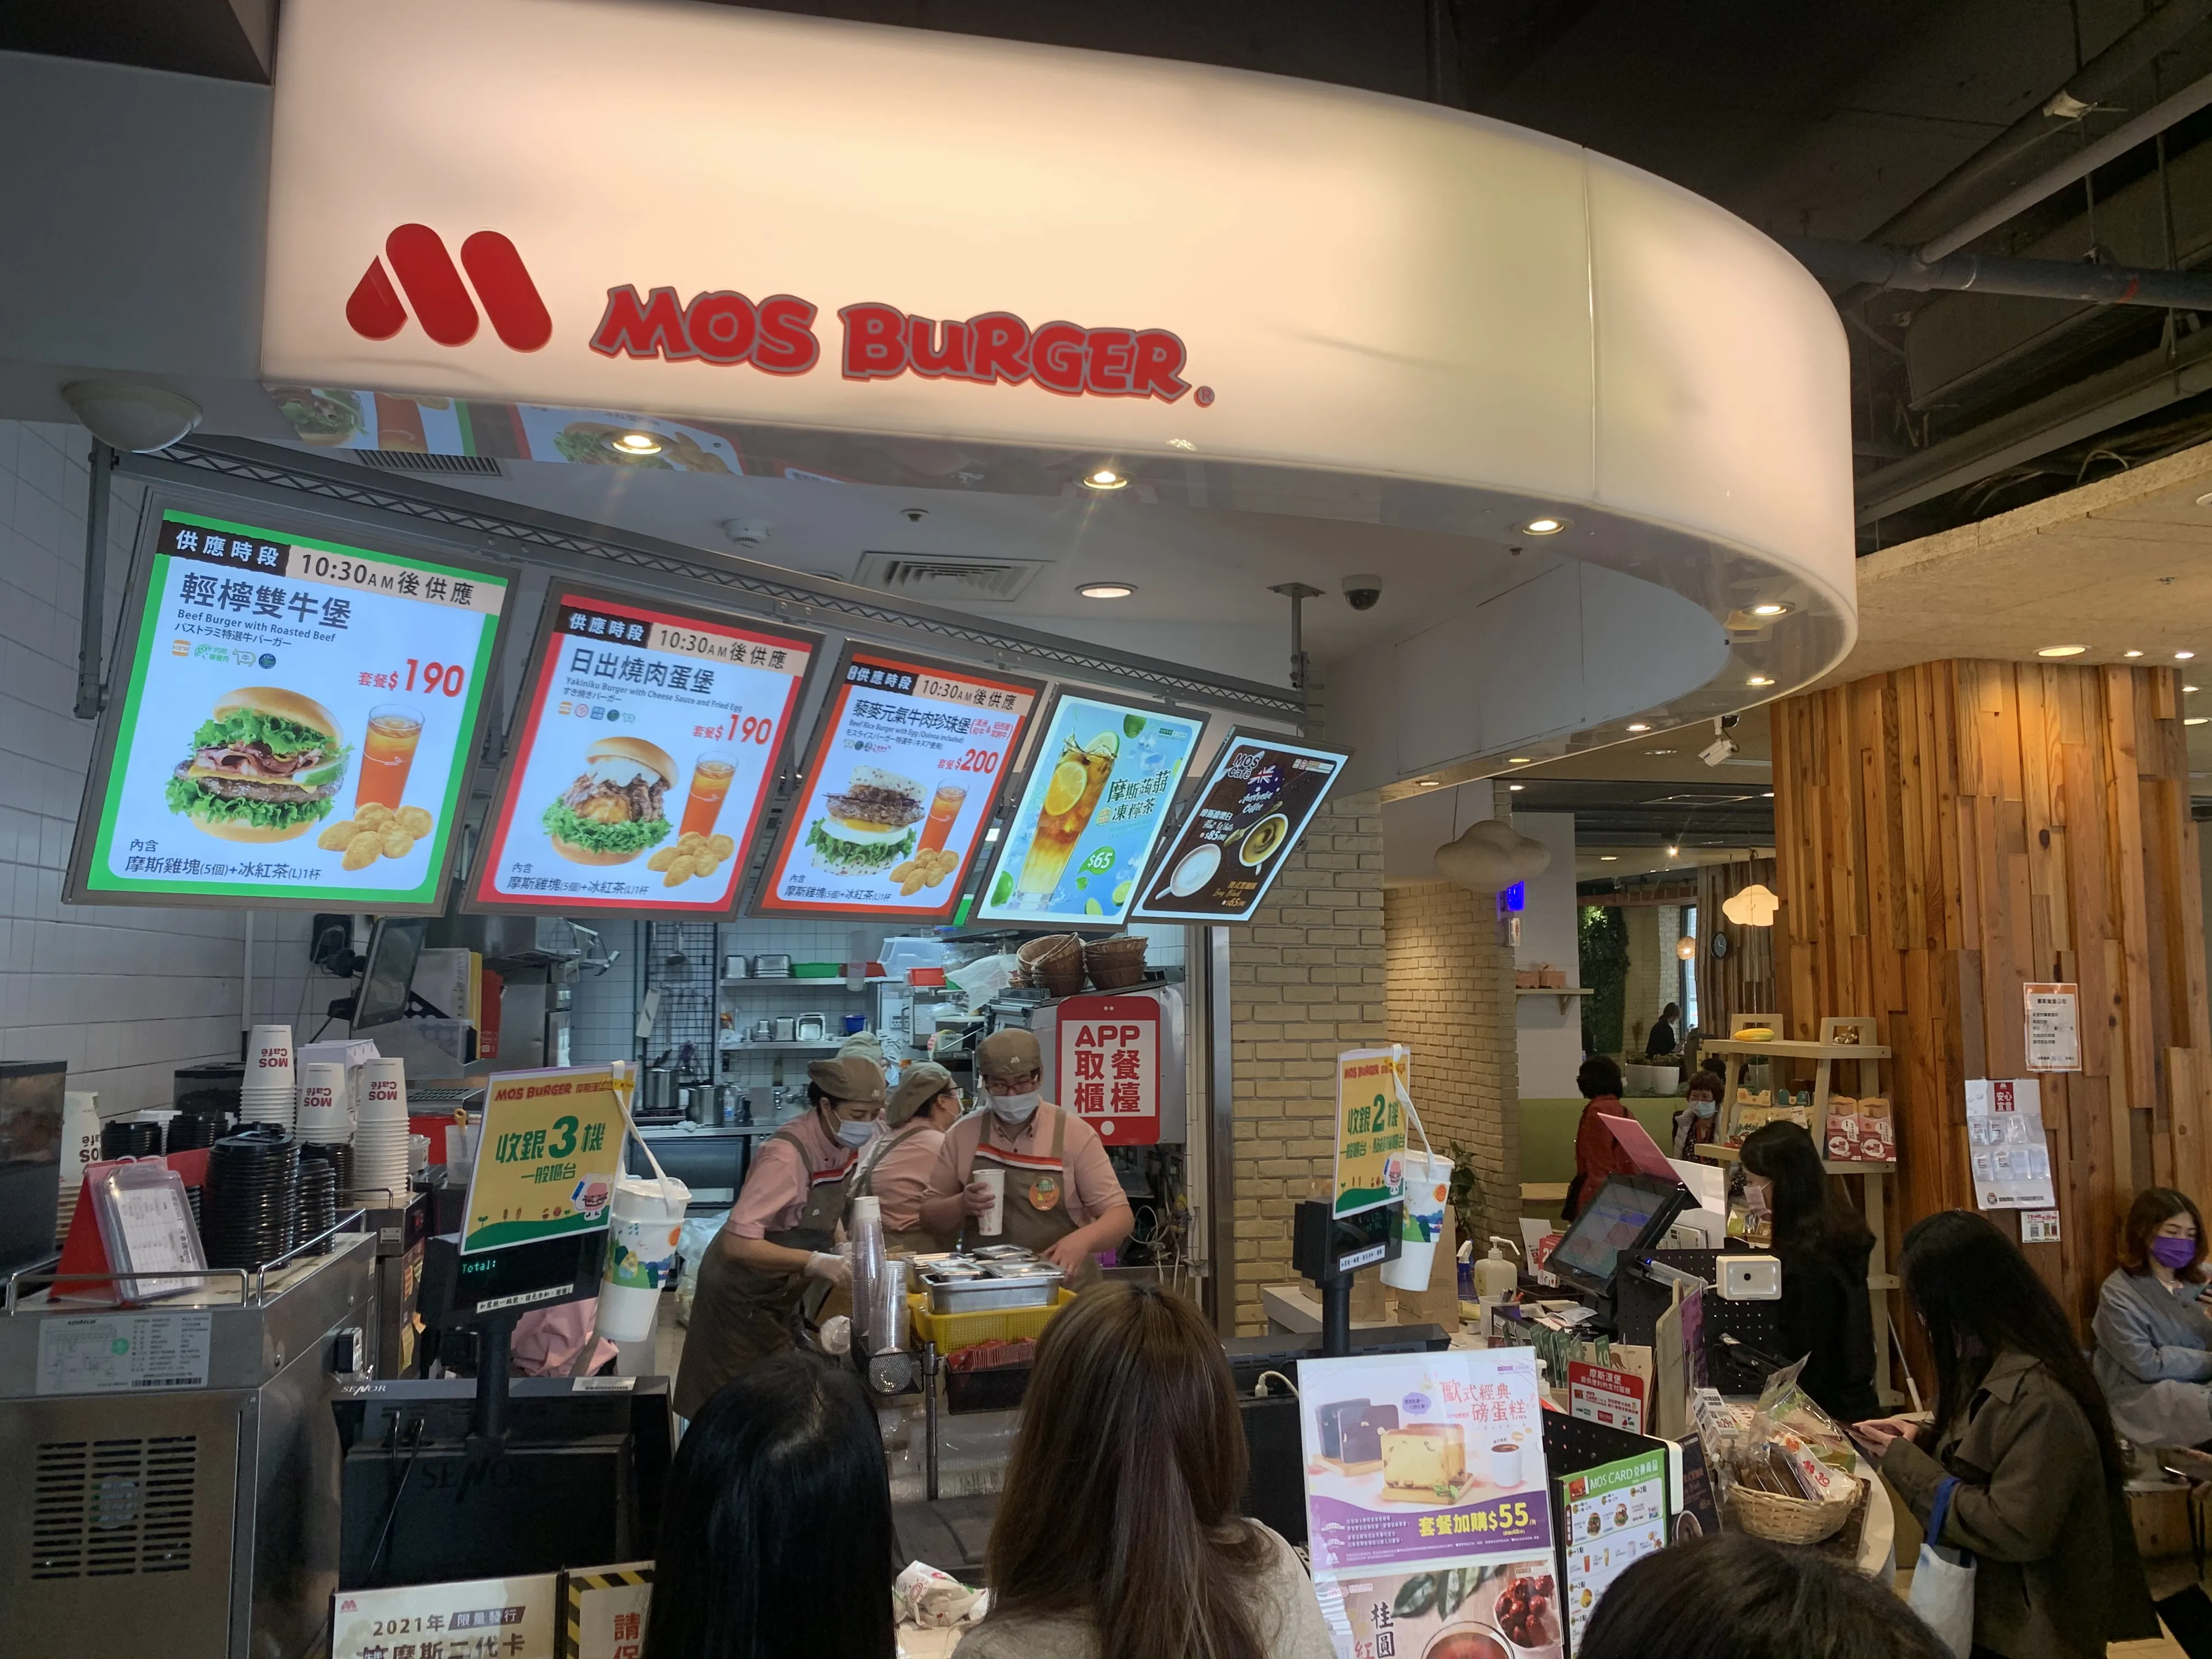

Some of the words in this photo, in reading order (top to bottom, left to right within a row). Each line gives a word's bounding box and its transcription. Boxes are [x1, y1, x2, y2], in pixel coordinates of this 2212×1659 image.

[589, 283, 821, 377] MOS
[837, 302, 1193, 405] BURGER
[176, 529, 279, 567] 供應時段
[180, 572, 352, 630] 輕檸雙牛堡
[174, 623, 292, 647] パストラミ特選牛バーガー
[178, 609, 203, 621] Beef
[206, 614, 242, 629] Burger
[245, 620, 267, 631] with
[270, 624, 311, 639] Roasted
[313, 631, 336, 642] Beef
[568, 613, 645, 642] 供應時段
[172, 644, 190, 652] NEW
[570, 647, 715, 695] 日出燒肉蛋堡
[856, 667, 912, 690] 供應時段
[566, 676, 600, 690] Yakiniku
[603, 683, 628, 695] Burger
[630, 687, 646, 697] with
[648, 690, 673, 701] Cheese
[674, 695, 695, 704] Sauce
[696, 698, 710, 707] and
[713, 701, 729, 709] Fried
[730, 703, 743, 713] Egg
[853, 699, 972, 735] 藜麥元氣牛肉珍珠堡
[876, 724, 895, 733] Burger
[1233, 753, 1260, 769] MOS
[1106, 770, 1171, 803] 摩斯蒟蒻
[1111, 797, 1156, 822] 凍檸茶
[1087, 851, 1113, 870] $65
[1074, 1025, 1141, 1048] APP
[258, 1058, 289, 1068] MOS
[1074, 1049, 1141, 1081] 取餐
[1344, 1068, 1357, 1080] MOS
[303, 1097, 332, 1107] MOS
[368, 1091, 398, 1101] MOS
[494, 1088, 524, 1102] MOS
[526, 1082, 573, 1099] BURGER
[1074, 1082, 1141, 1114] 櫃檯
[81, 1134, 100, 1147] afé
[521, 1163, 576, 1184] 一般櫃台
[462, 1260, 496, 1274] Total:
[1589, 1368, 1621, 1385] 摩斯漢堡
[341, 1385, 386, 1396] SENOR
[1439, 1379, 1511, 1404] 歐式經典
[1471, 1399, 1527, 1423] 磅蛋糕
[1590, 1474, 1607, 1490] MOS
[1608, 1469, 1633, 1484] CARD
[373, 1614, 445, 1636] 2021年
[457, 1609, 517, 1627] 限量發行
[1370, 1601, 1395, 1658] 桂圓
